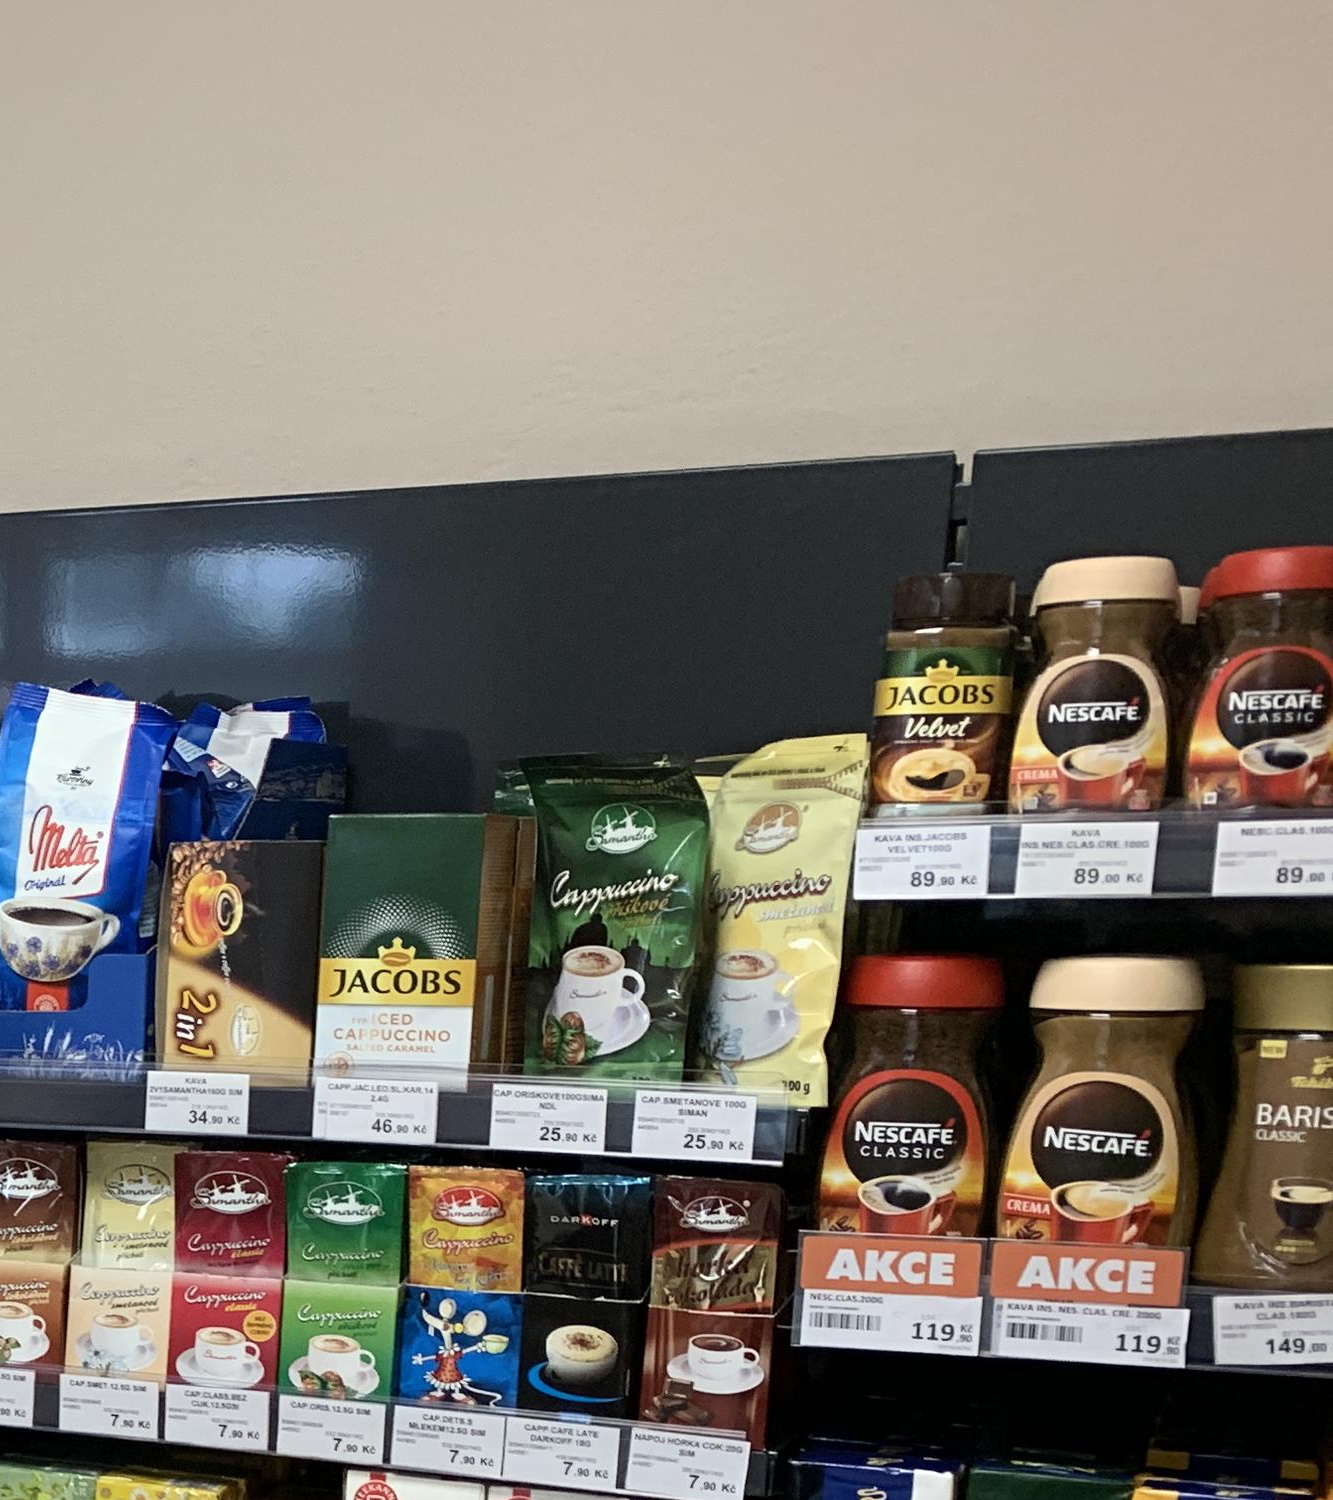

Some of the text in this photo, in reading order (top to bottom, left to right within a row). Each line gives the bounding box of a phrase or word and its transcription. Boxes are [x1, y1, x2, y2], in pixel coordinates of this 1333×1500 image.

[886, 684, 994, 709] JACOBS
[1048, 696, 1141, 723] NESCAFÉ
[904, 715, 972, 739] Velvet
[1017, 768, 1057, 780] CREMA
[29, 804, 101, 886] Melta
[550, 868, 681, 917] Cappuccino
[331, 968, 461, 997] JACOBS
[333, 1027, 451, 1044] CAPPUCCINO
[678, 1108, 708, 1117] SIMAN
[413, 1124, 427, 1135] Kč
[854, 1118, 956, 1146] NESCAFÉ
[1255, 1129, 1306, 1143] CLASSIC
[729, 1139, 744, 1151] Kč
[1043, 1126, 1151, 1157] NESCAFÉ
[860, 1146, 944, 1160] CLASSIC
[1006, 1199, 1051, 1215] CREMA
[550, 1214, 619, 1227] DARKOFF
[187, 1234, 271, 1255] Cappuccino
[825, 1247, 955, 1286] AKCE
[1017, 1255, 1157, 1295] AKCE
[911, 1322, 955, 1342] 119
[1115, 1333, 1161, 1354] 119
